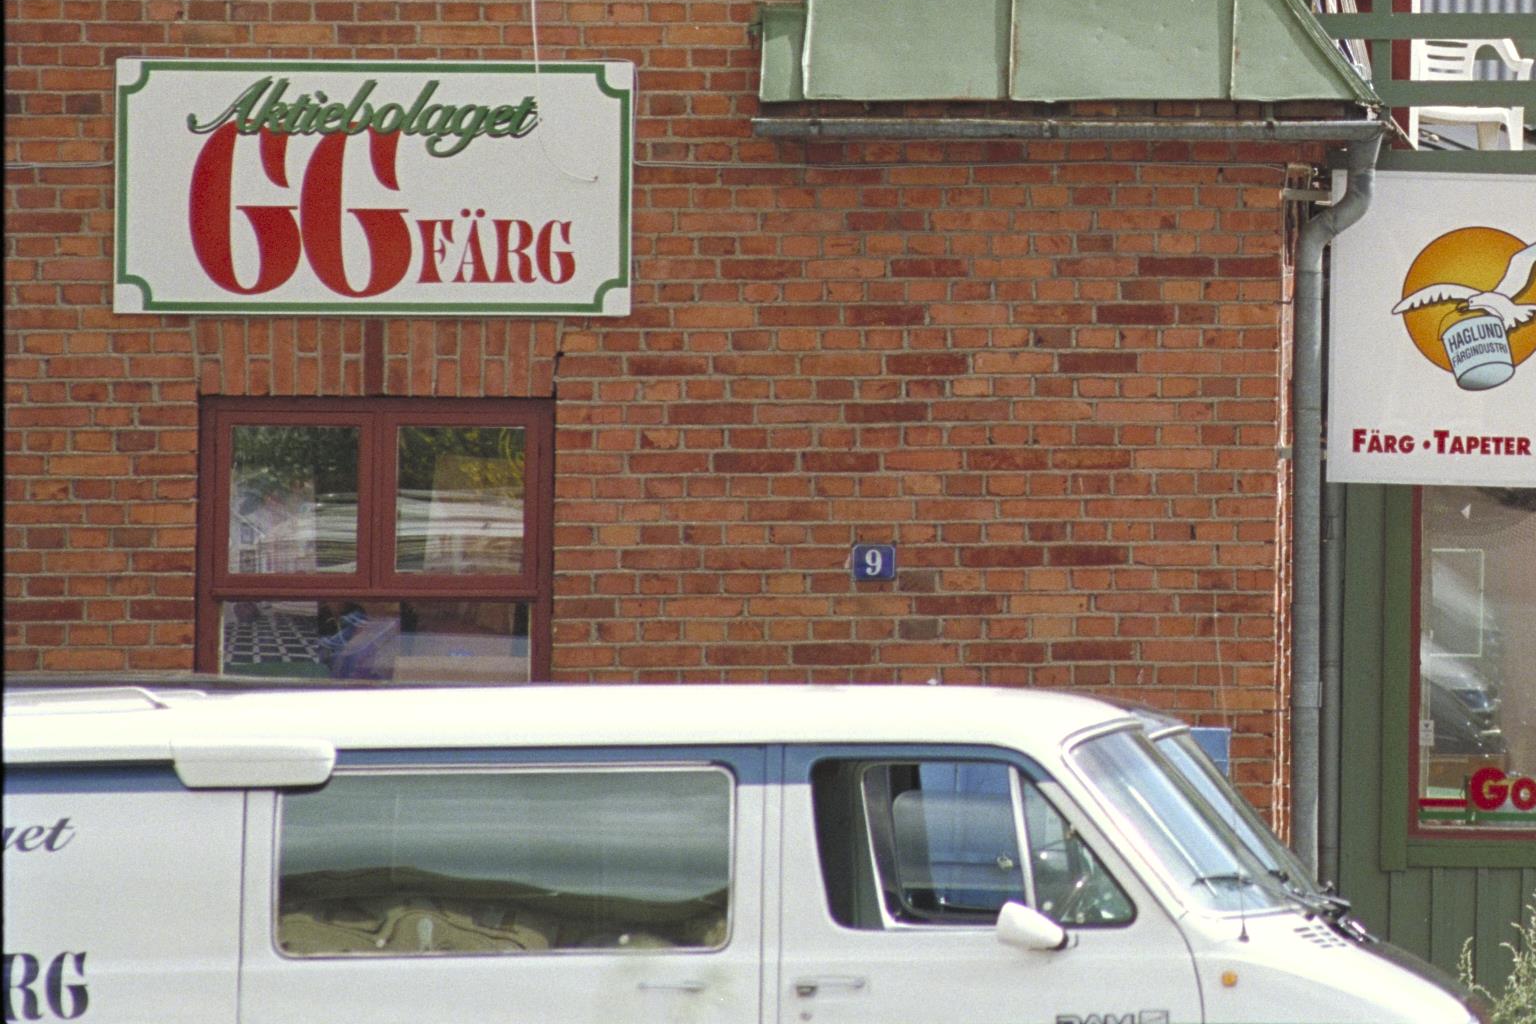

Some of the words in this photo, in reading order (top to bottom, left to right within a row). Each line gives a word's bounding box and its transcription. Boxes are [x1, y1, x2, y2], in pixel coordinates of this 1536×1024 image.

[187, 76, 543, 158] Aktiebolaget
[188, 117, 413, 298] GG
[415, 208, 577, 284] FÄRG
[1448, 322, 1504, 354] HAGLUND
[1452, 342, 1509, 367] FÄRGINDUSTRI
[865, 549, 882, 576] 9
